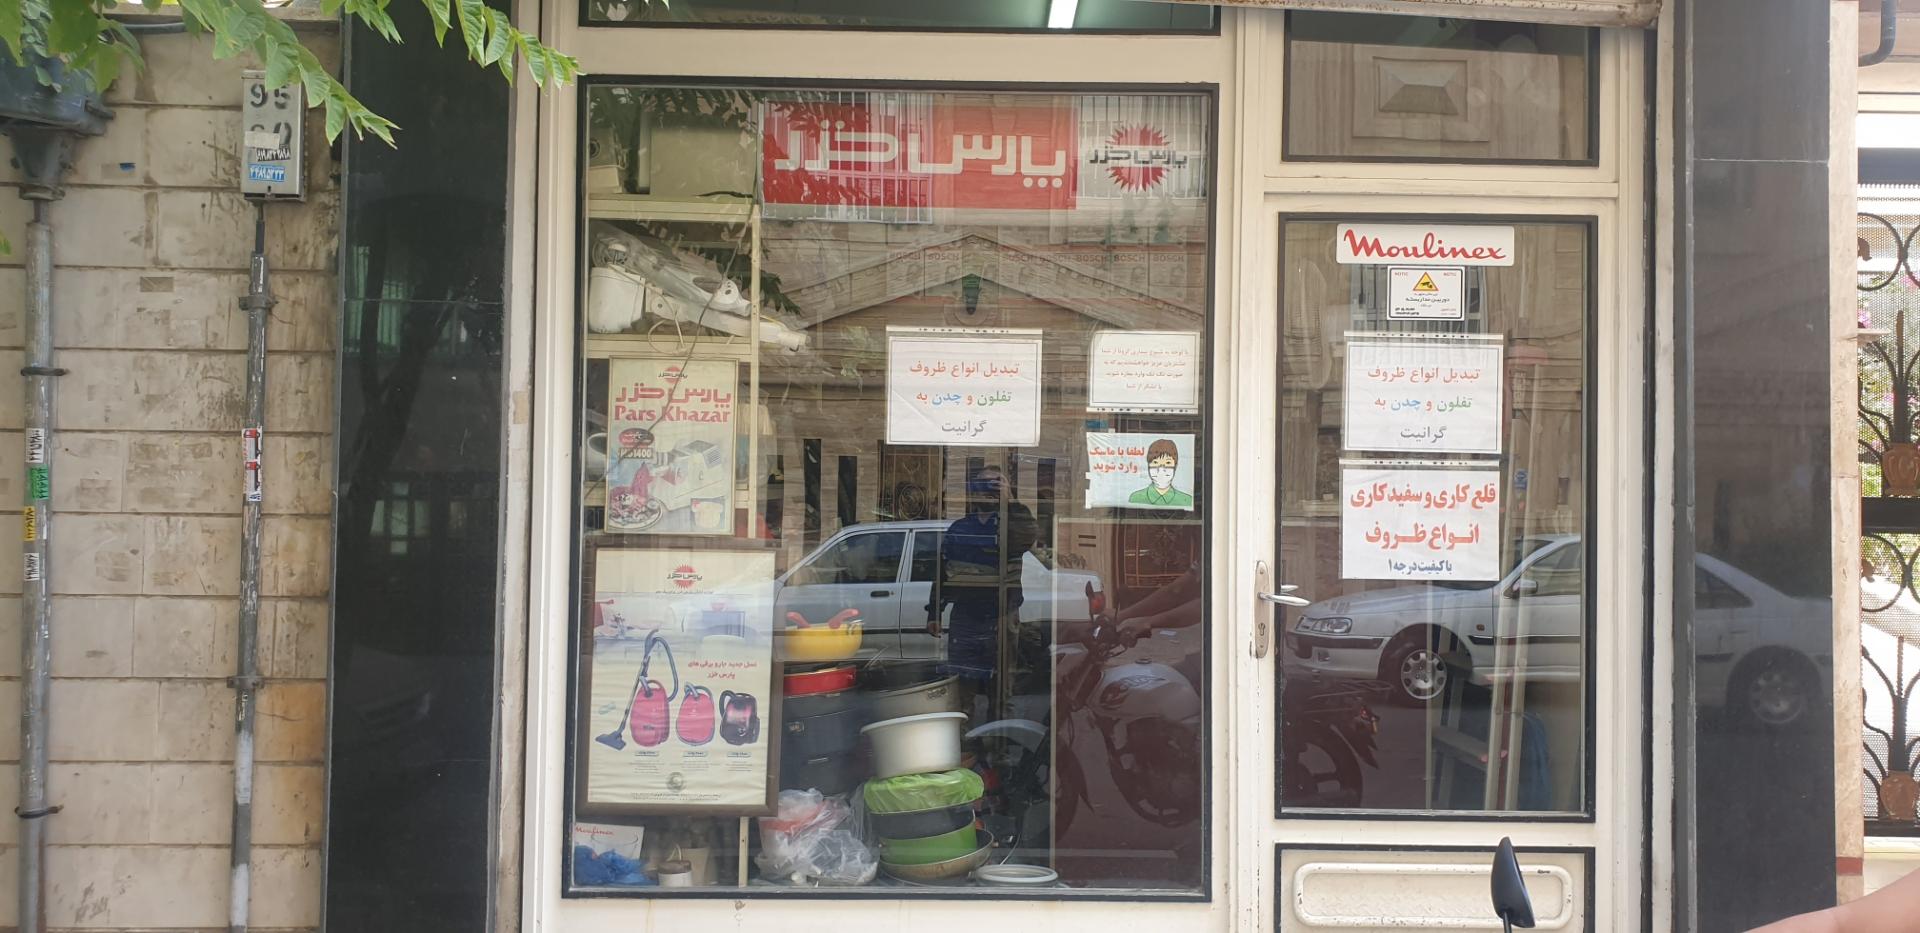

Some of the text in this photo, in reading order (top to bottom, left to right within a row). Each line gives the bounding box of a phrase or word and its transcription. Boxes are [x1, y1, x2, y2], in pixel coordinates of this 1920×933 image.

[775, 119, 1067, 189] پارس خزر
[1088, 144, 1188, 169] پارس خزر
[1343, 228, 1507, 260] Moulinex
[1113, 254, 1145, 263] BOSCH
[910, 360, 1020, 378] تبدیل انواع ظروف
[1367, 365, 1481, 384] تبدیل انواع ظروف
[615, 382, 732, 409] پارس خزر
[916, 390, 1012, 406] تفلون و چدن به
[1374, 396, 1473, 412] تفلون و چدن به
[614, 404, 731, 423] Pars Khazar
[941, 420, 987, 437] گرانیت
[1400, 425, 1447, 443] گرانیت
[1089, 446, 1145, 458] لطفا با ماسک
[1093, 461, 1138, 474] وارد شوید
[1423, 492, 1432, 508] و
[1433, 484, 1470, 509] کاری
[1471, 483, 1496, 509] قلع
[1365, 521, 1480, 550] انواع ظروف
[1393, 560, 1418, 575] درجه
[1418, 559, 1446, 575] کیفیت
[719, 671, 736, 680] پارس
